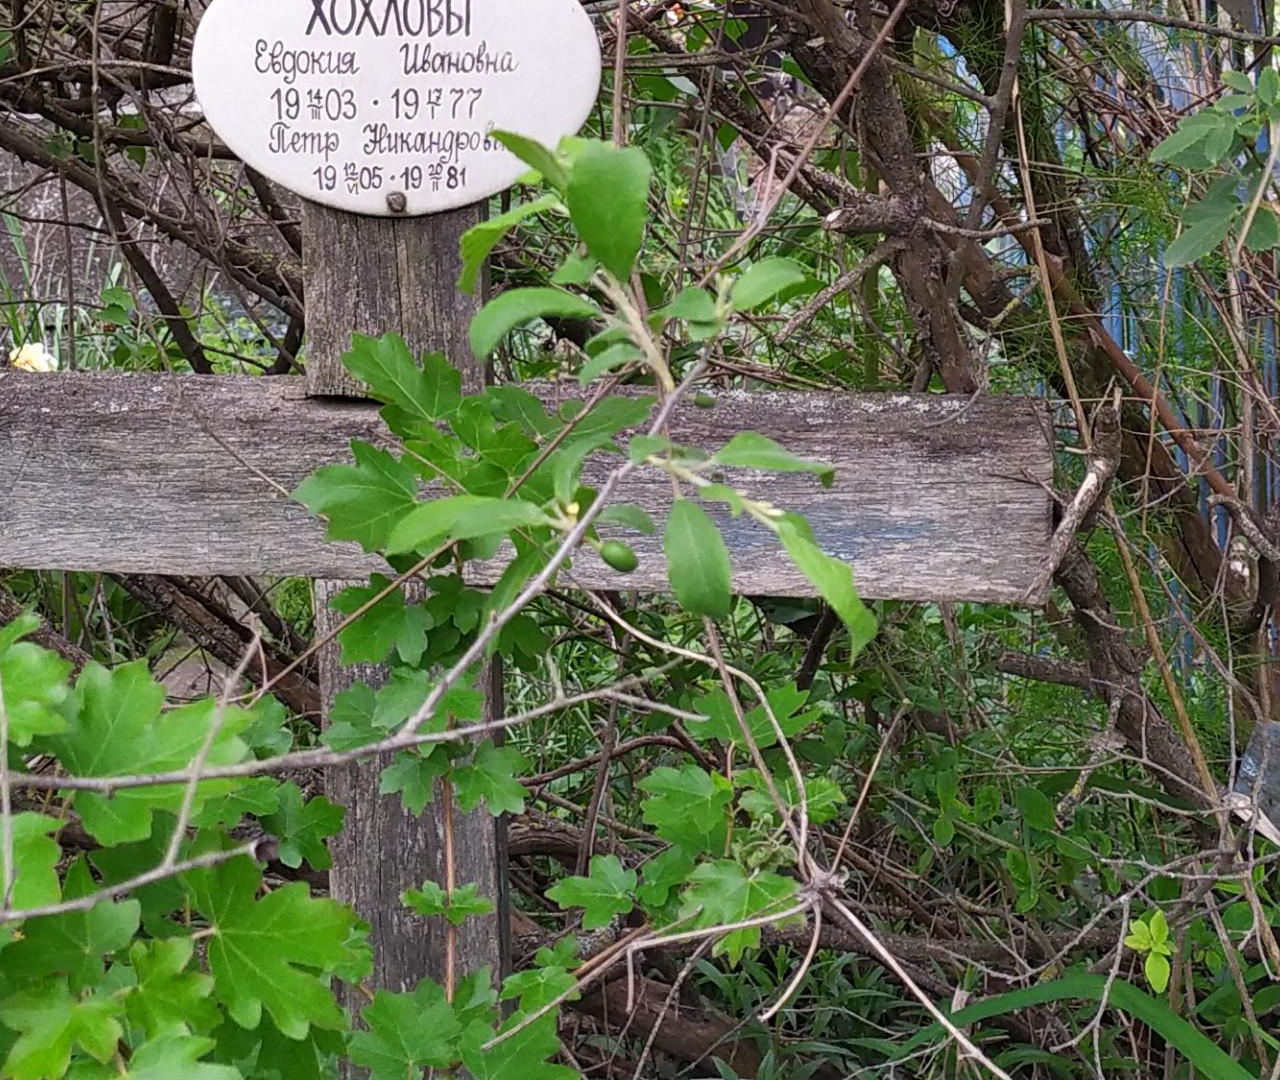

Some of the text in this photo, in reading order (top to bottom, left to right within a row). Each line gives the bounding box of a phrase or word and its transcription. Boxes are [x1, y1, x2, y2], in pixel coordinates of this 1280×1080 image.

[254, 38, 520, 84] Евдокия Ивановна
[268, 121, 340, 163] Петр
